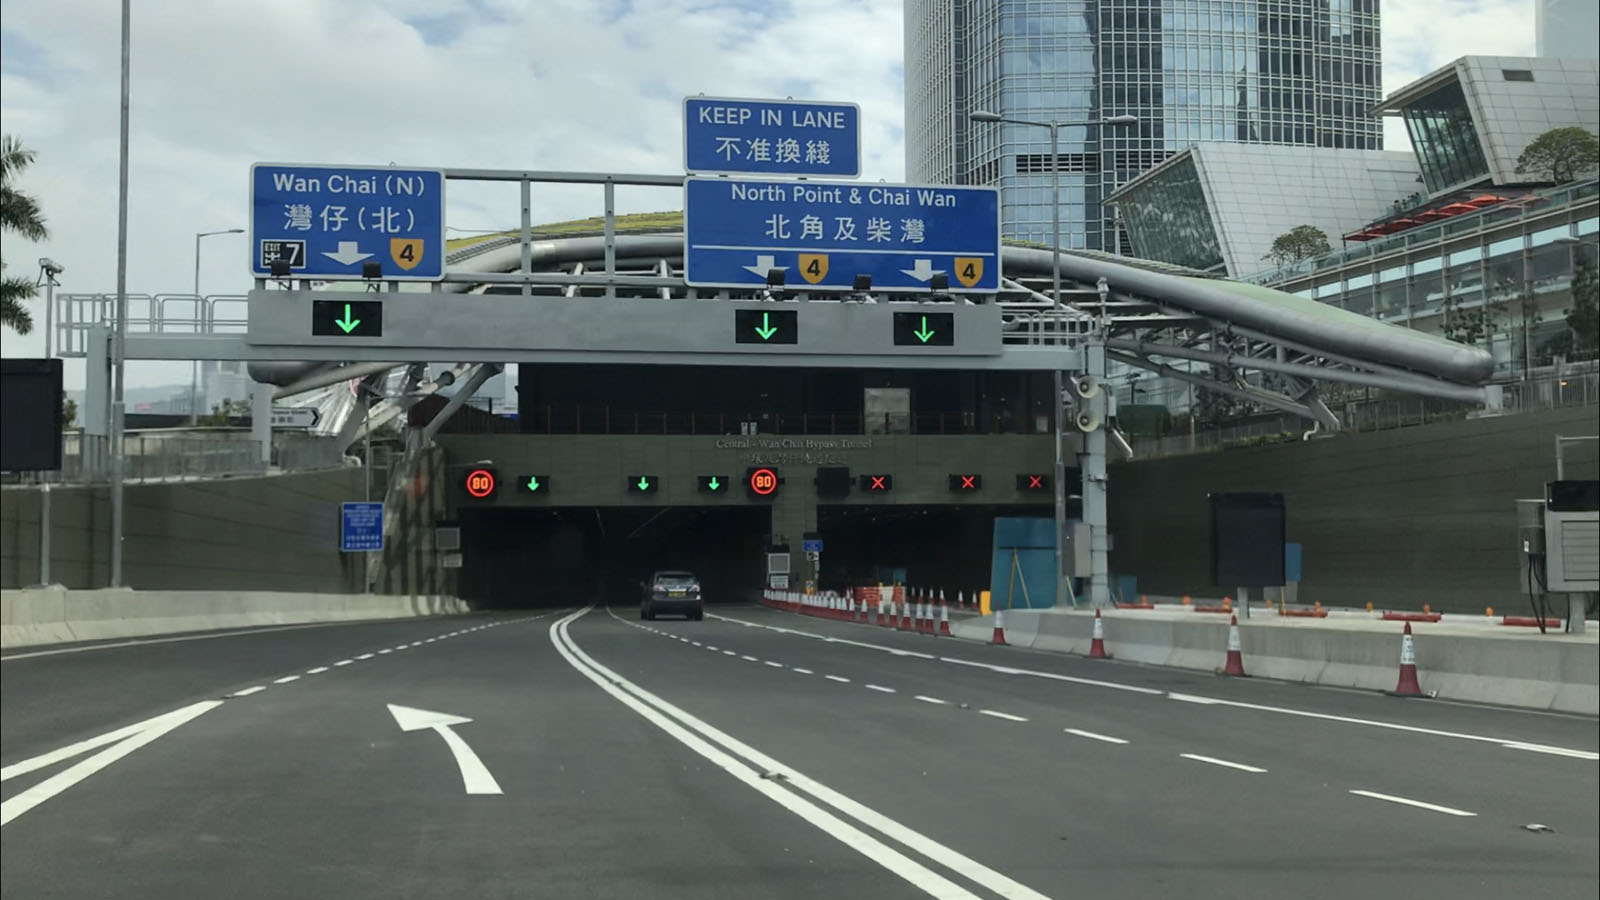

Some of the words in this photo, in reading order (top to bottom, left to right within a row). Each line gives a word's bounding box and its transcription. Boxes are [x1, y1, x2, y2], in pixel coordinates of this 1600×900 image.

[699, 106, 751, 126] KEEP
[761, 109, 782, 127] IN
[792, 111, 845, 129] LANE
[715, 137, 831, 166] 不准換綫
[273, 173, 321, 194] Wan
[328, 175, 377, 195] Chai
[385, 176, 425, 197] (N)
[731, 184, 786, 203] North
[793, 185, 842, 205] Point
[849, 188, 862, 206] &
[869, 188, 910, 206] Chai
[918, 190, 956, 208] Wan
[284, 204, 415, 233] 灣仔(北)
[765, 213, 926, 244] 北角及柴灣
[264, 243, 281, 252] EXIT
[286, 243, 300, 265] 7
[399, 244, 414, 262] 4
[806, 259, 821, 277] 4
[962, 262, 976, 280] 4
[716, 439, 750, 449] Central
[759, 439, 780, 449] Wan
[841, 439, 872, 449] Tunnel
[472, 477, 489, 490] 80
[756, 476, 771, 488] 80
